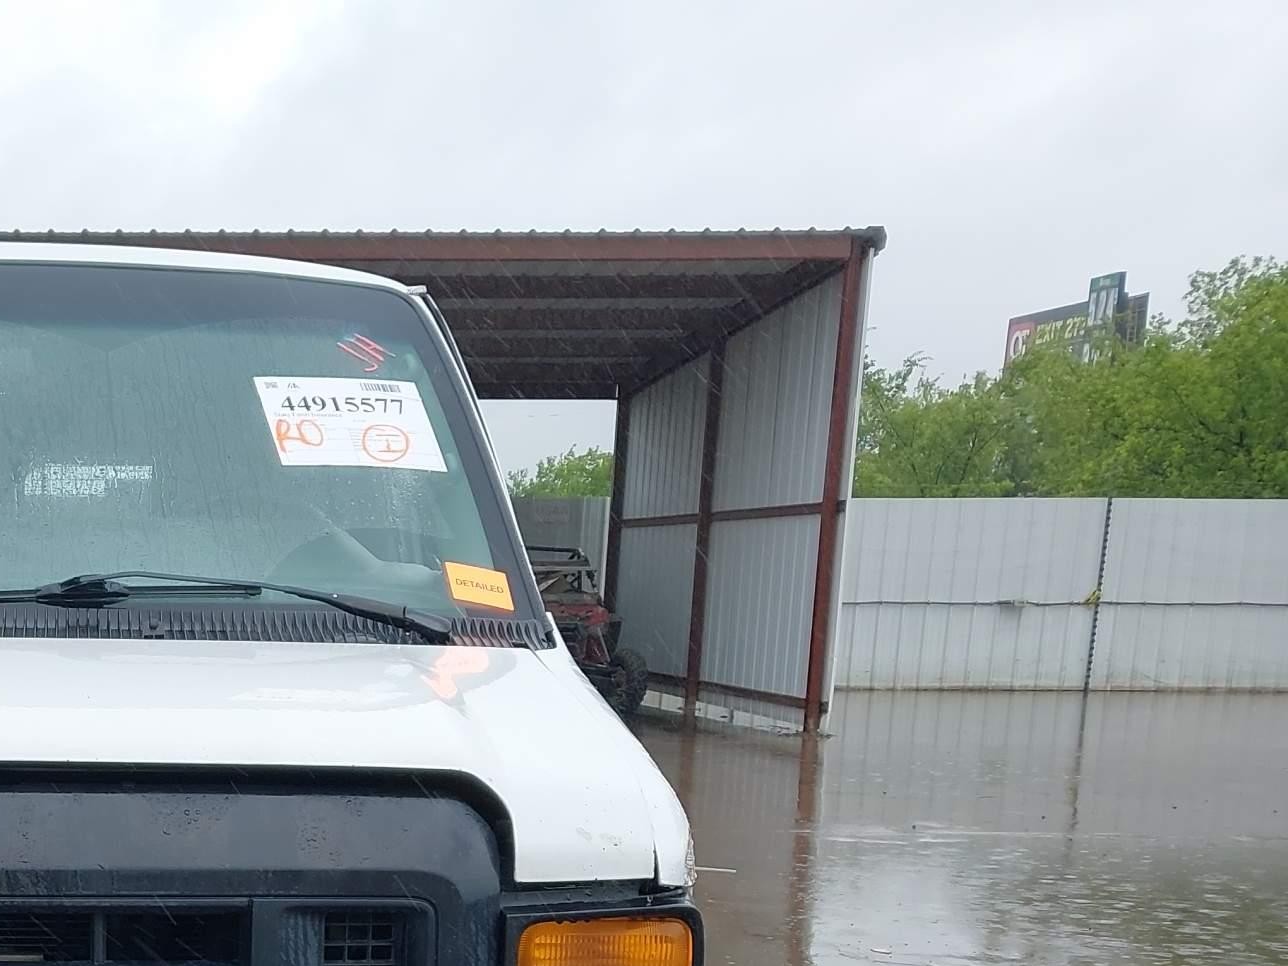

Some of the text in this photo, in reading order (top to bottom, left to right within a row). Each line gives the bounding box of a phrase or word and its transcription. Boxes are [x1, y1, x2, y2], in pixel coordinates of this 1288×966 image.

[1035, 320, 1063, 344] EXIT
[281, 395, 403, 415] 44915577
[455, 578, 504, 594] DETAILED
